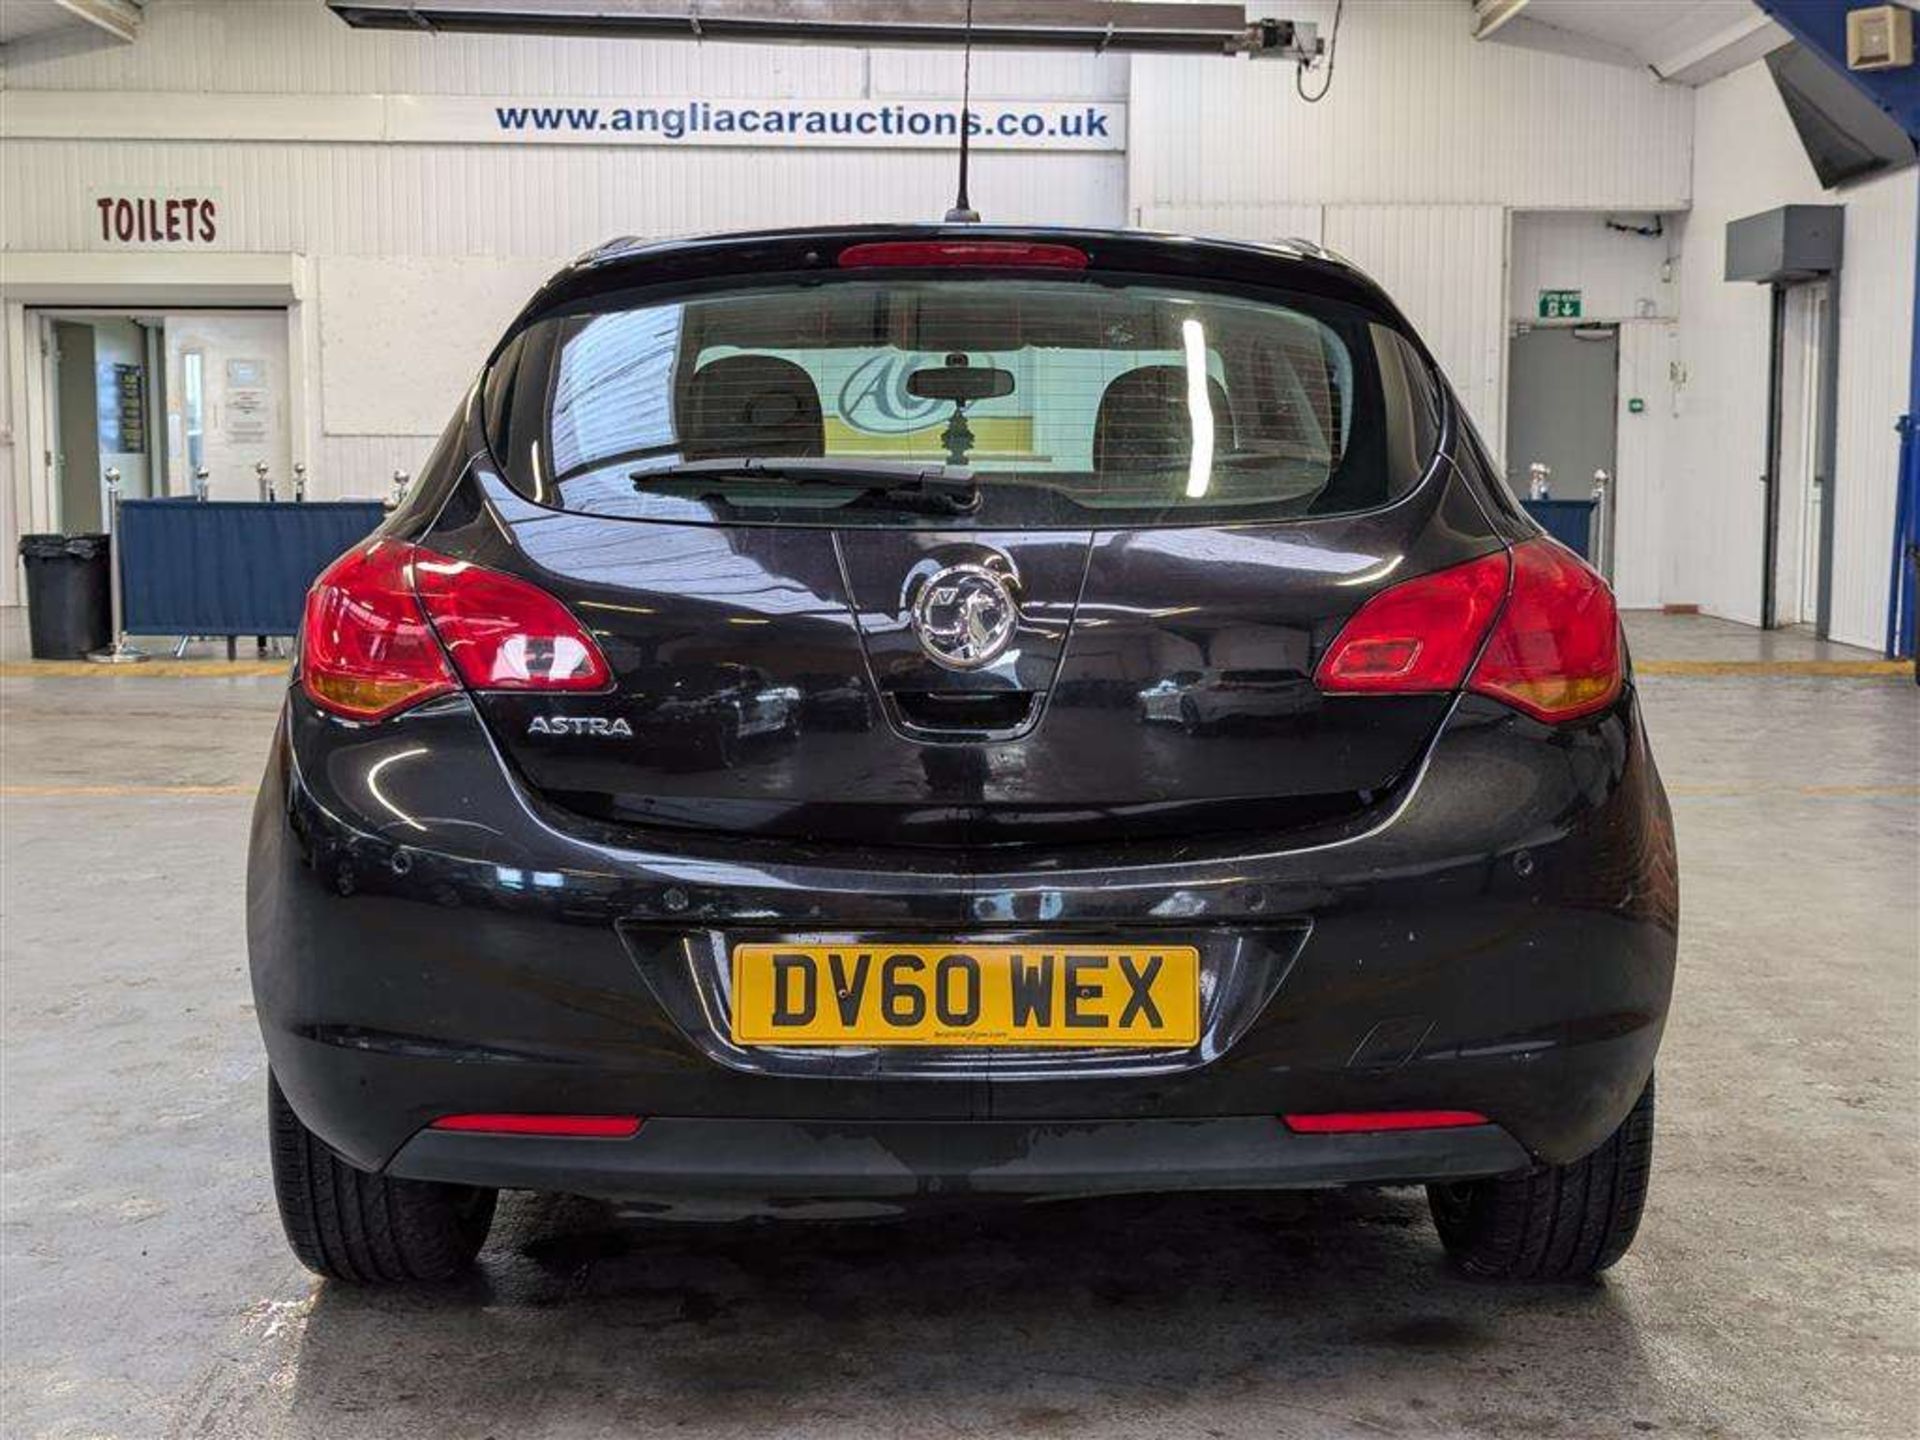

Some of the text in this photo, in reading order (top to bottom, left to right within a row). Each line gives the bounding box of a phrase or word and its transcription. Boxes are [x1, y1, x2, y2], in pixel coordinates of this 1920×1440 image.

[495, 102, 1109, 138] www.angliacarauctions.co.uk
[97, 197, 216, 242] TOILETS
[527, 716, 633, 736] ASTRA
[771, 953, 1164, 1029] DV60 WEX
